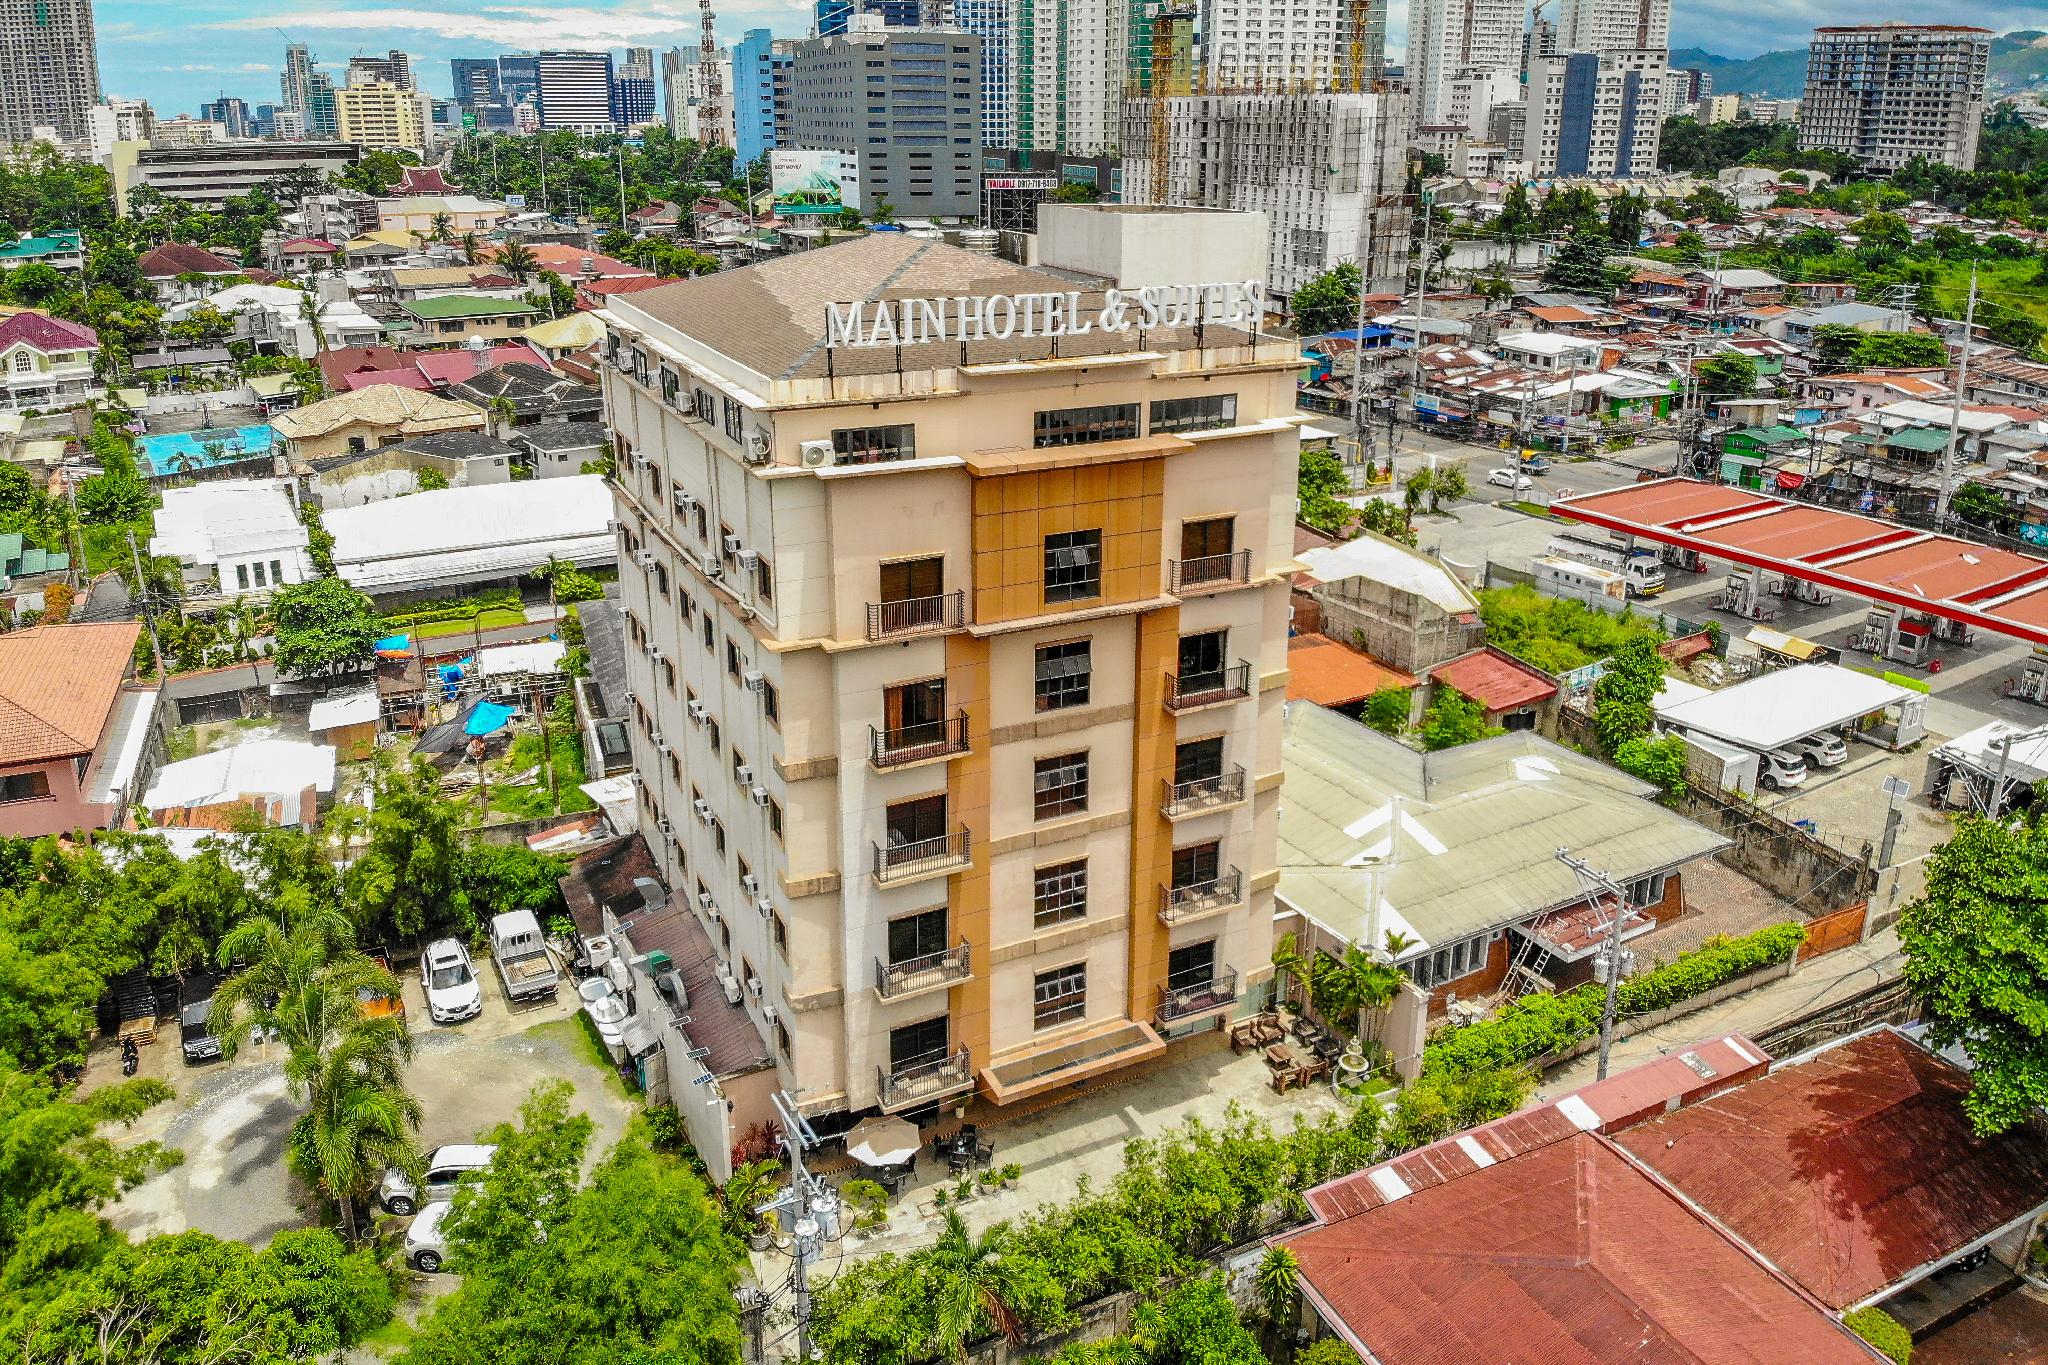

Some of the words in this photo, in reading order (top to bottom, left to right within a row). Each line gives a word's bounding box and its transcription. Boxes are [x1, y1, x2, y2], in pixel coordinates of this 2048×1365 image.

[988, 179, 1016, 189] VAILABLE
[825, 301, 946, 350] MAIN
[956, 291, 1093, 342] HOTEL
[1100, 288, 1131, 333] &
[1138, 279, 1264, 331] SUITES
